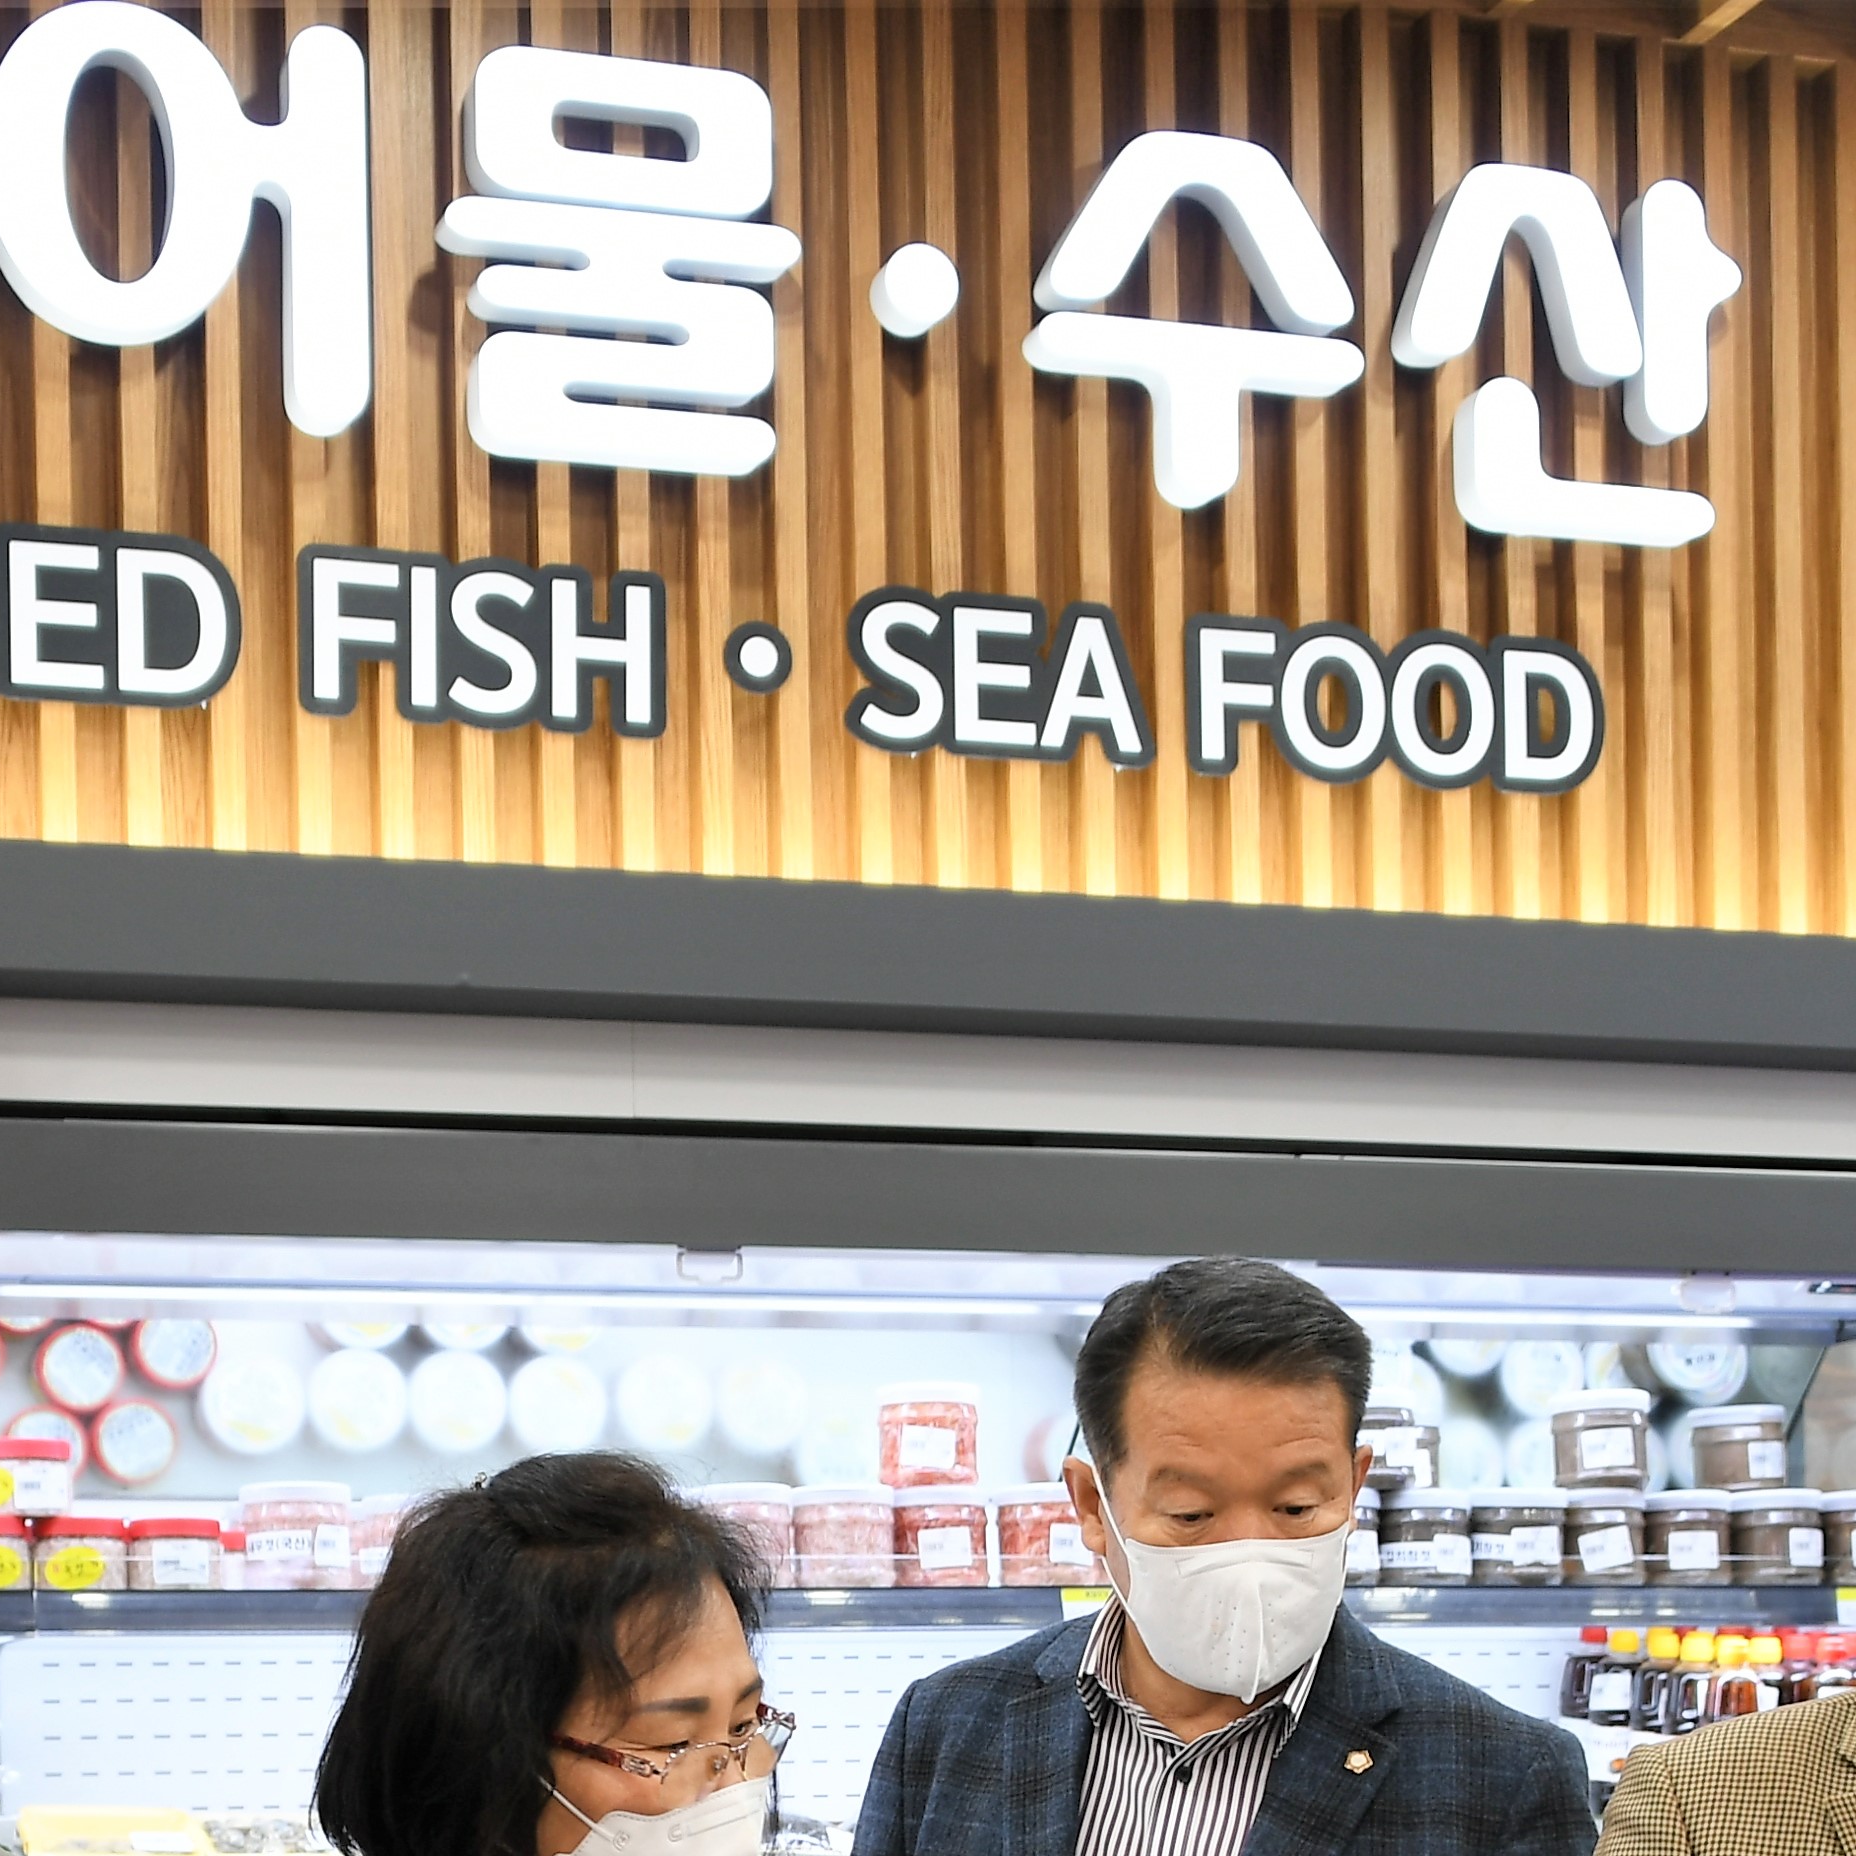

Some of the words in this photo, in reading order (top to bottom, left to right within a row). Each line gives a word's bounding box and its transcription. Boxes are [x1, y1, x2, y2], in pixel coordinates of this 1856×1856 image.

[308, 553, 653, 729] FISH
[854, 597, 1143, 758] SEA
[1195, 626, 1597, 786] FOOD
